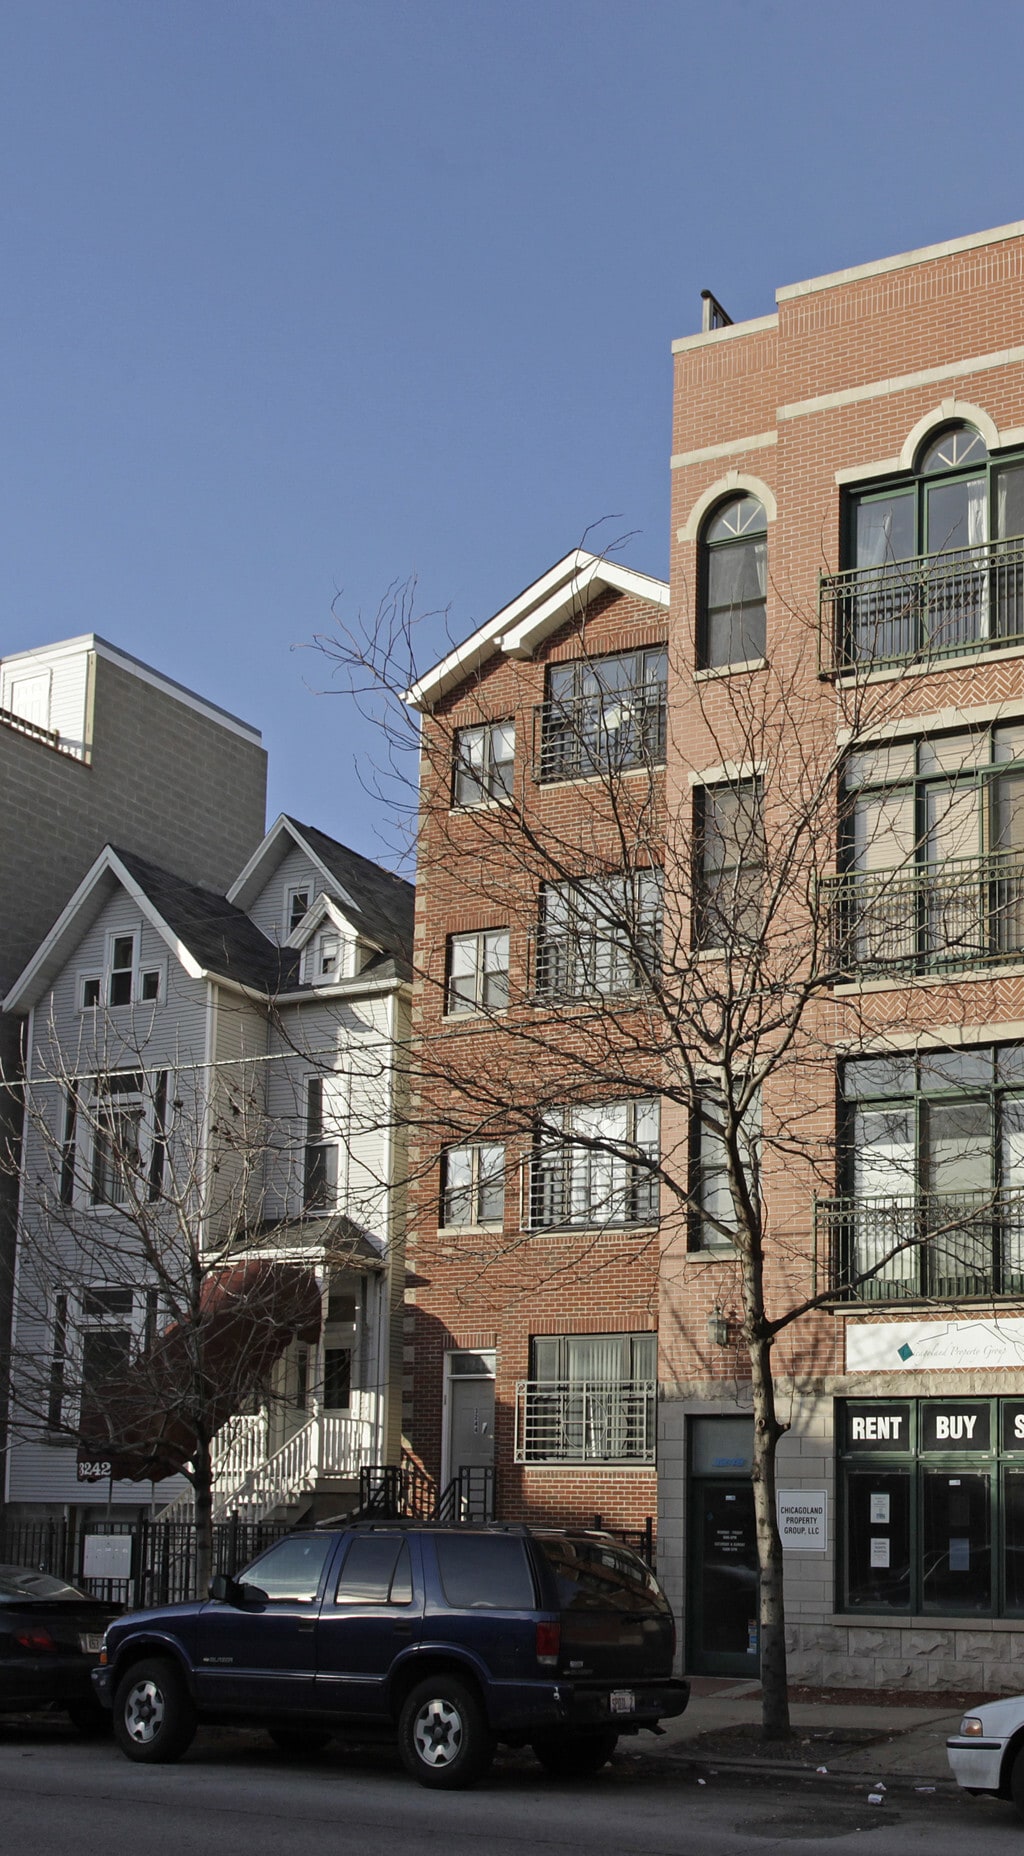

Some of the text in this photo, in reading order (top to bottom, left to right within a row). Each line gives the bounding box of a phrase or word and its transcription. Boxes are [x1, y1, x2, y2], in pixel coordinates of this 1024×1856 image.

[983, 1345, 1006, 1363] Group
[852, 1417, 902, 1440] RENT
[936, 1416, 977, 1439] BUY
[79, 1462, 111, 1476] 3242
[780, 1506, 823, 1514] CHICAGOLAND
[786, 1516, 817, 1524] PROPERTY
[784, 1526, 820, 1535] GROUP, LLC
